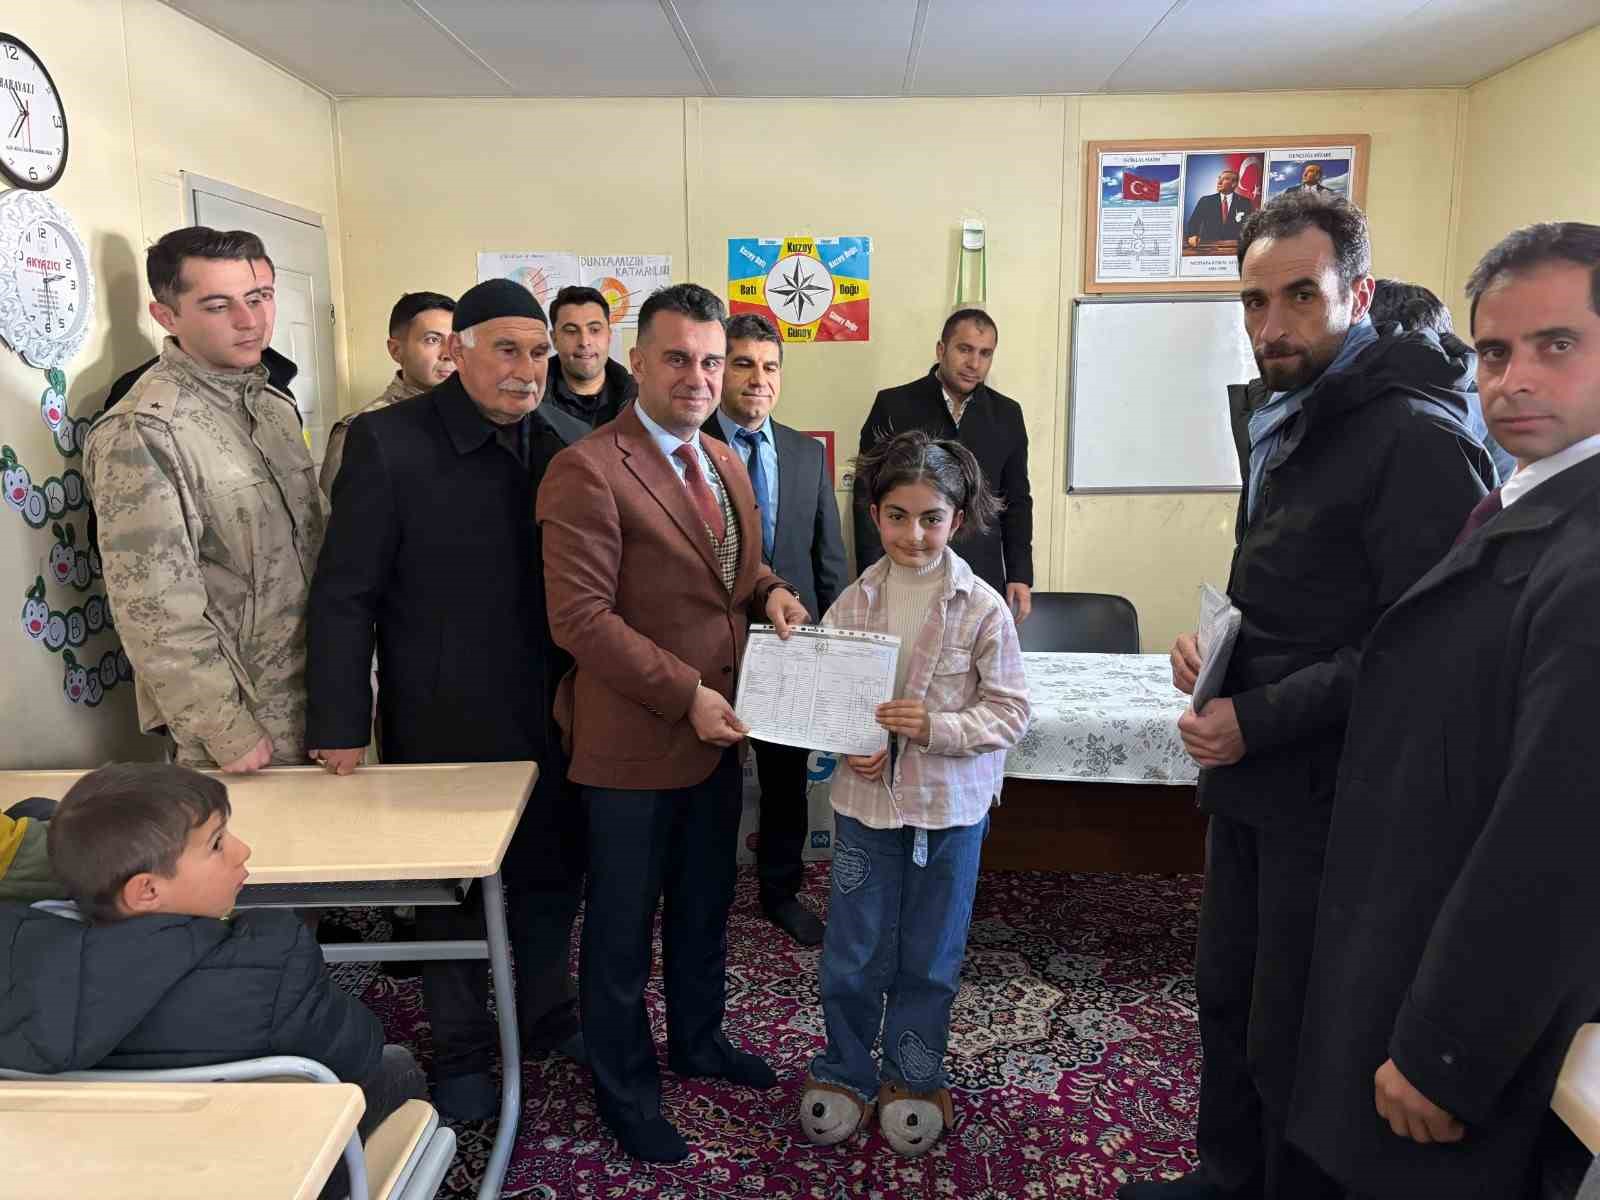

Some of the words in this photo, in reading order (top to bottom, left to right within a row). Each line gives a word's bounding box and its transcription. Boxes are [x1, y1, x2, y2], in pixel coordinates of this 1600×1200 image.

[3, 44, 19, 60] 12
[29, 166, 38, 180] 6
[38, 226, 46, 239] 12
[787, 242, 812, 254] Kuzey
